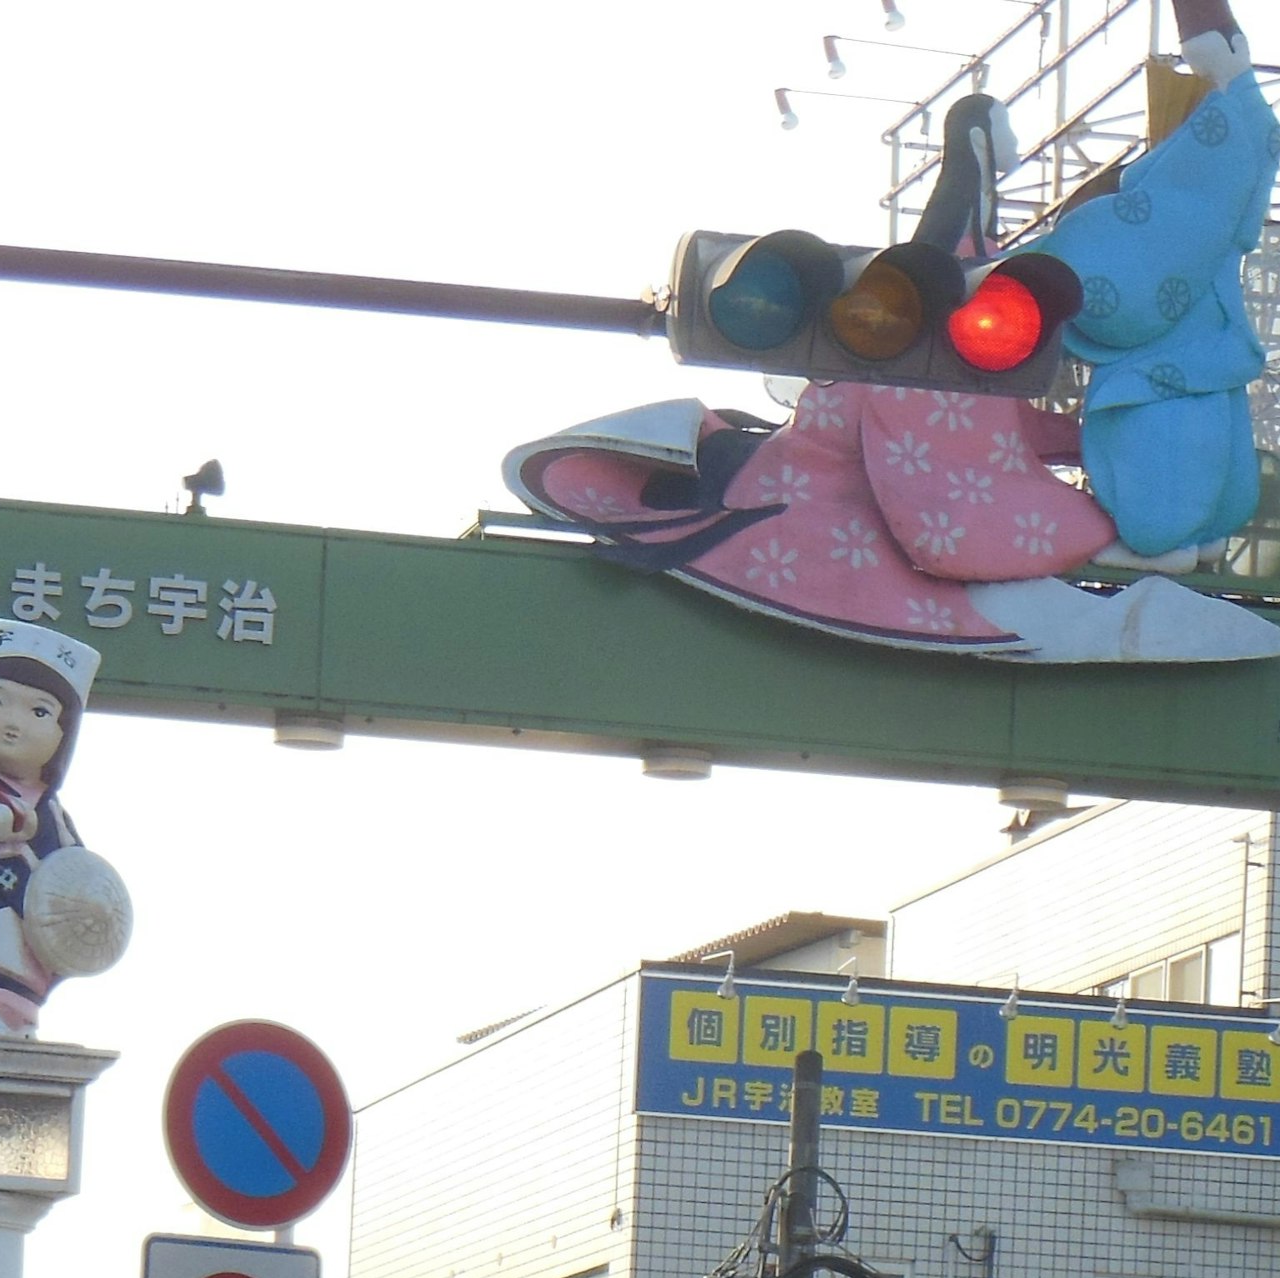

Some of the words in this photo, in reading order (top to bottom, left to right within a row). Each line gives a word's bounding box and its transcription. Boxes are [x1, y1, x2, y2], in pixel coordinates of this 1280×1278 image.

[686, 1007, 1273, 1087] 個別指導の明光義塾
[915, 1093, 984, 1128] TEL
[996, 1098, 1273, 1148] 0774-20-6461
